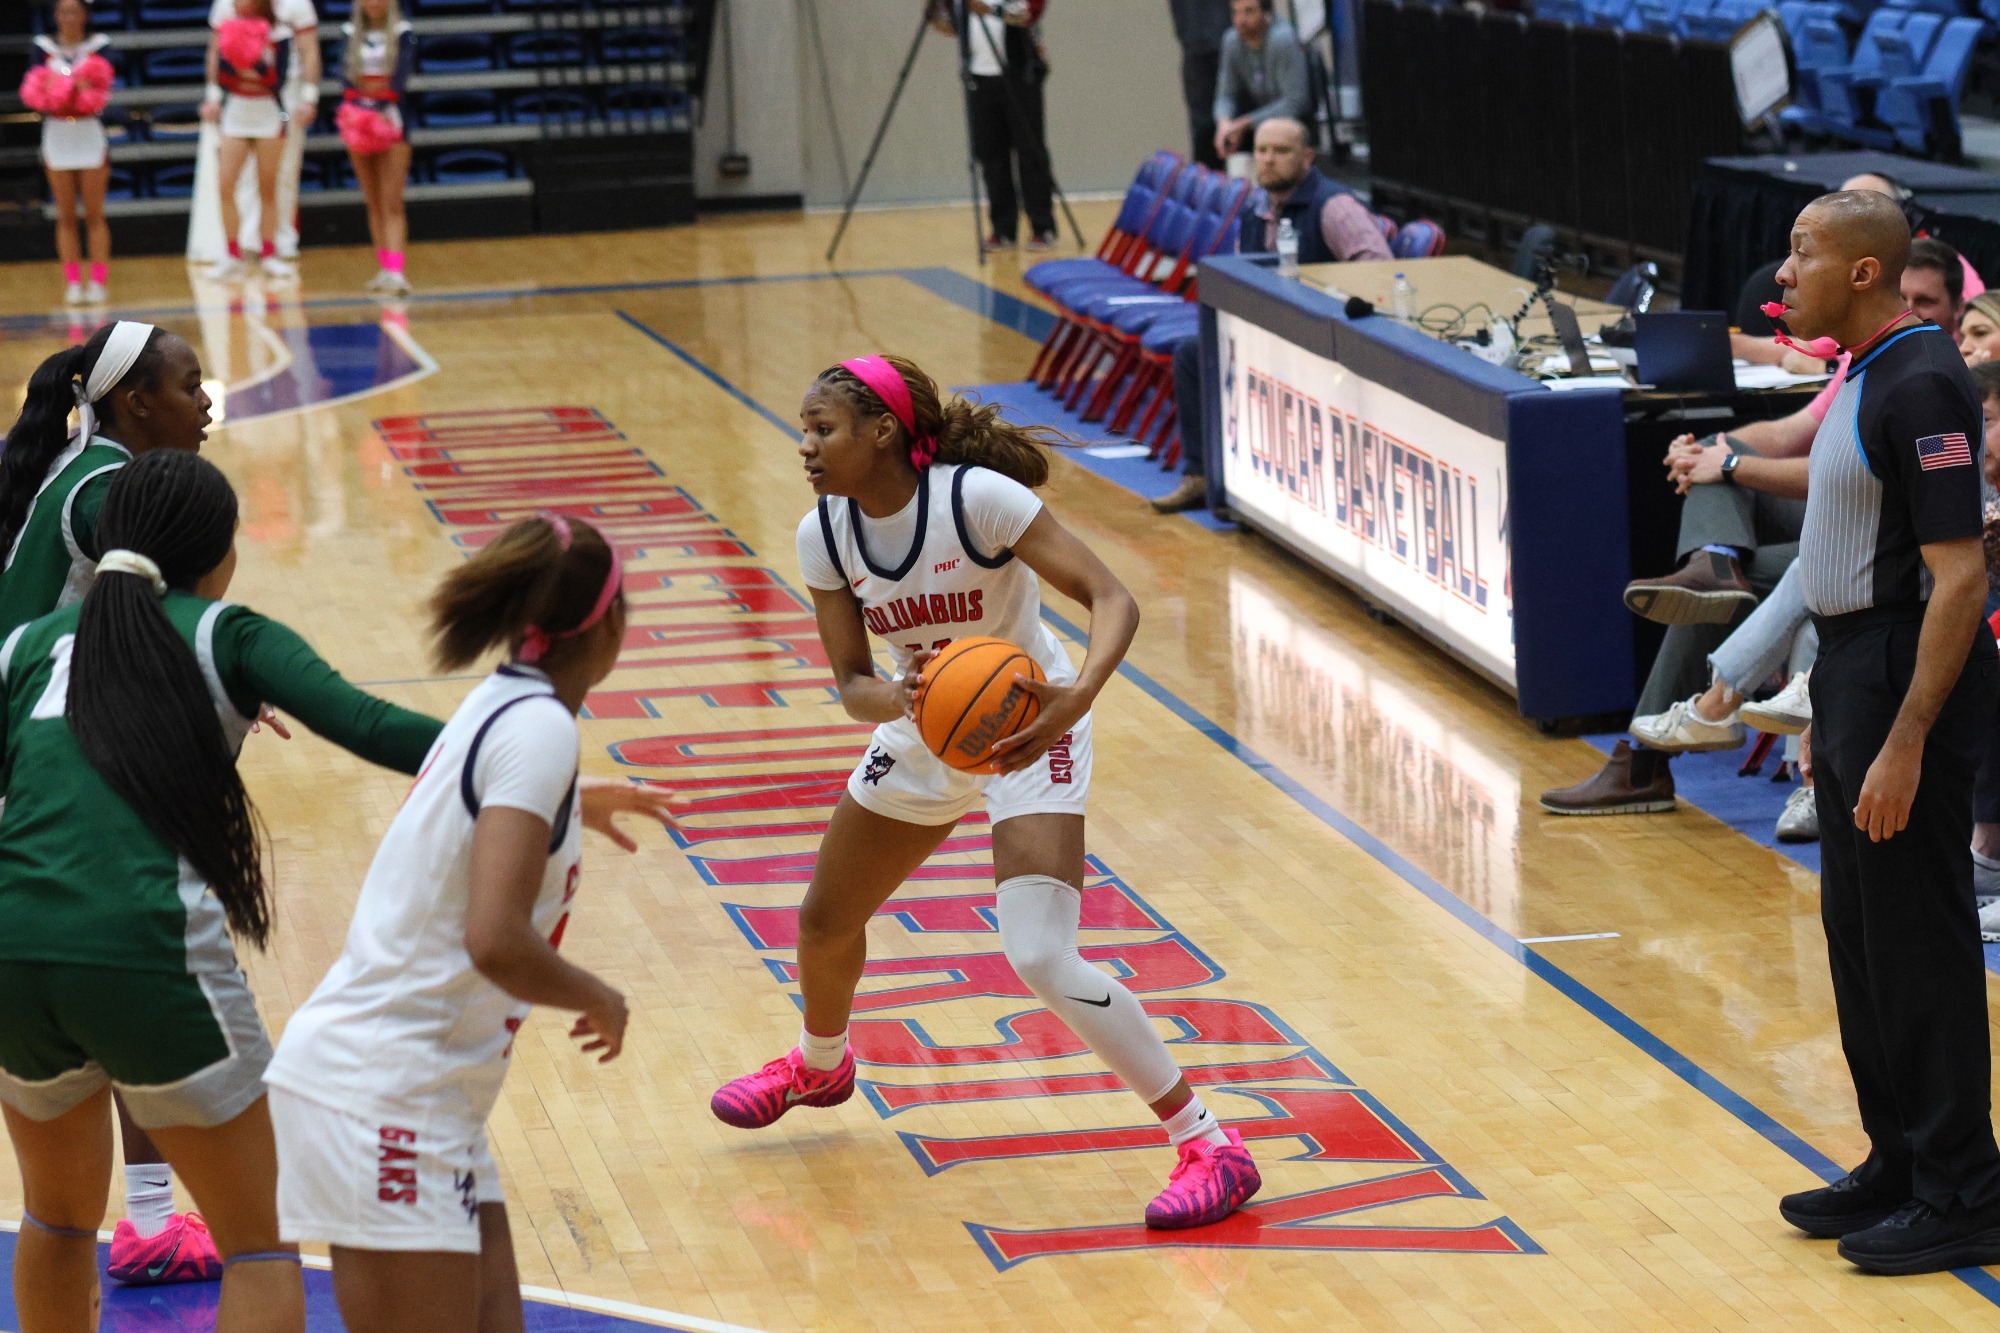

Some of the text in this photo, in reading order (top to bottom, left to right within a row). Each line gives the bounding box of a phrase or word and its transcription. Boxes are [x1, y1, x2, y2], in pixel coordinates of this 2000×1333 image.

[1247, 366, 1489, 615] COUGAR BASKETBALL
[934, 558, 960, 574] PBC
[863, 589, 983, 635] OLUMBUS
[957, 681, 1025, 758] Wilson
[606, 722, 1548, 1272] UNIVERSITY
[378, 1125, 418, 1206] GARS
